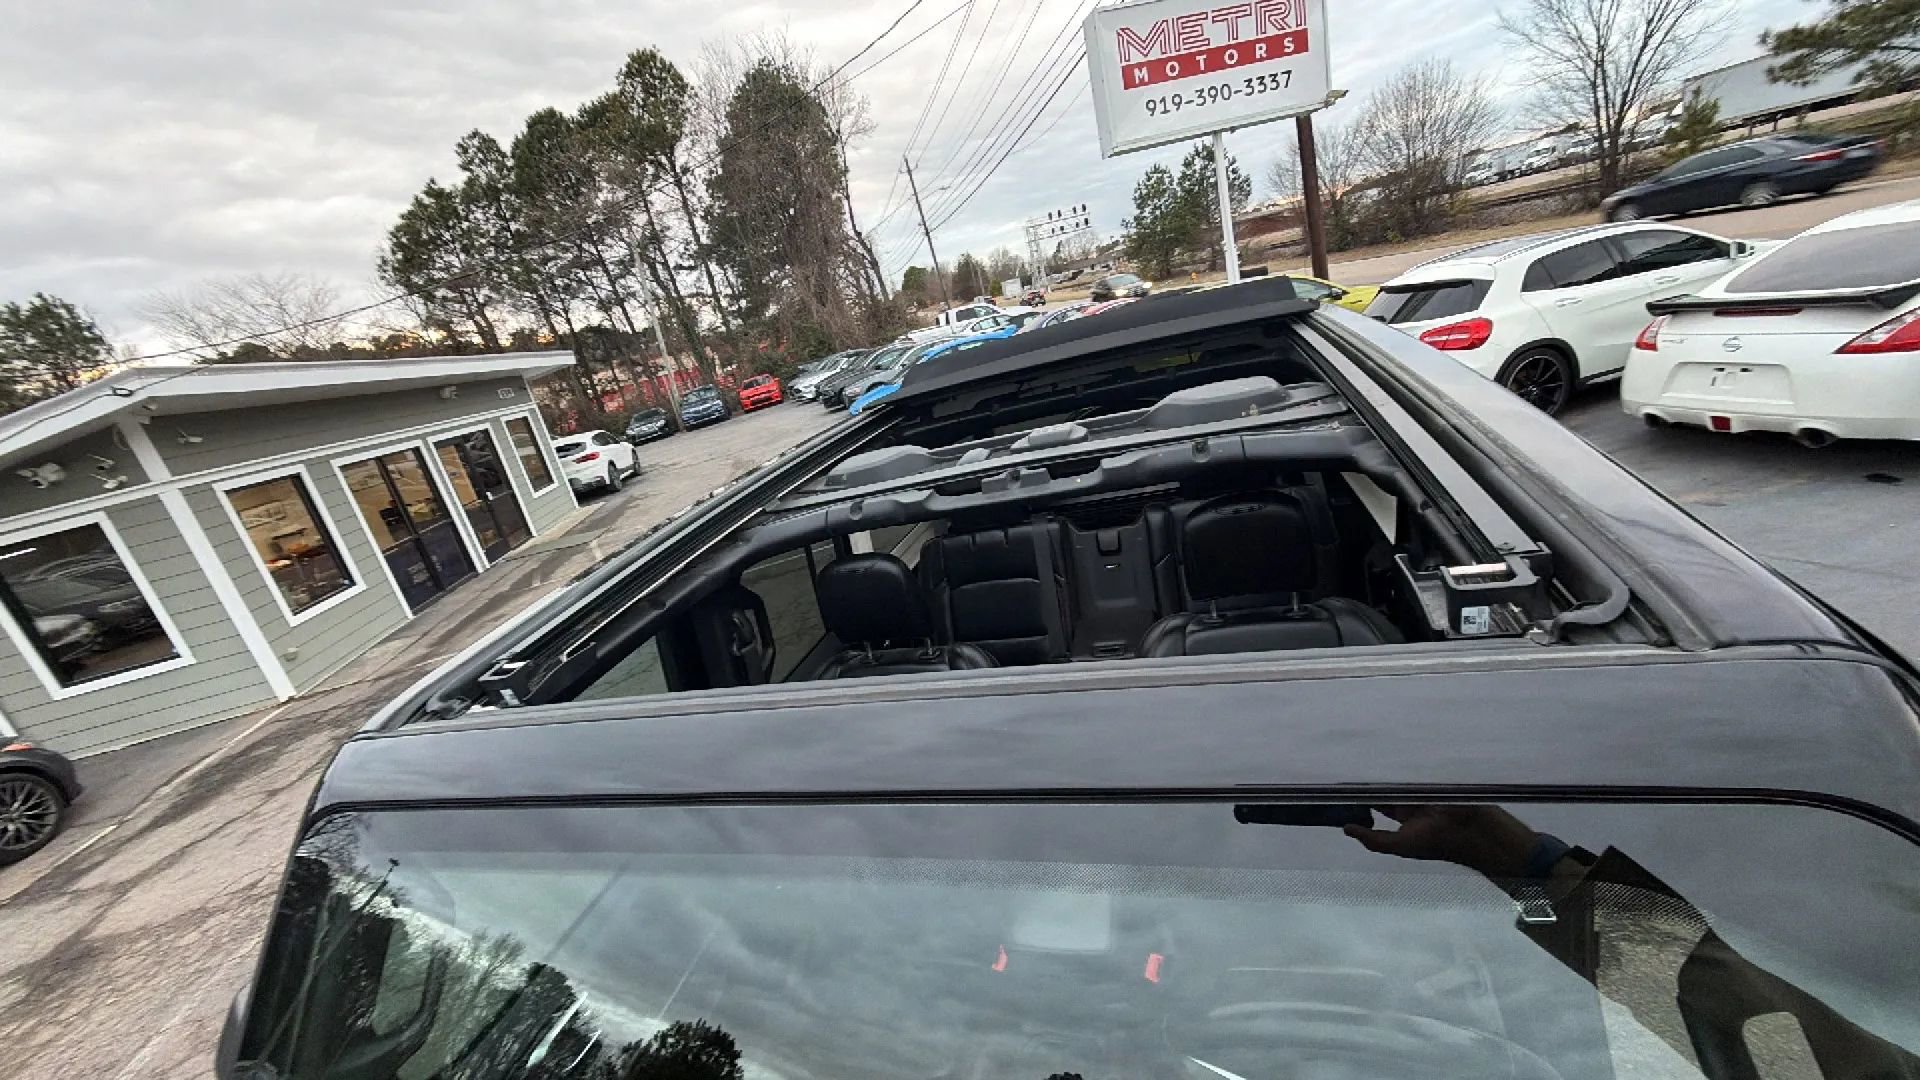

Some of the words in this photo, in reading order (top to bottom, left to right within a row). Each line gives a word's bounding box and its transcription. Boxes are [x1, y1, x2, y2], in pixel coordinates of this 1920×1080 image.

[1116, 0, 1306, 63] METRI
[1133, 37, 1295, 84] MOTORS
[1145, 70, 1293, 117] 919-390-3337
